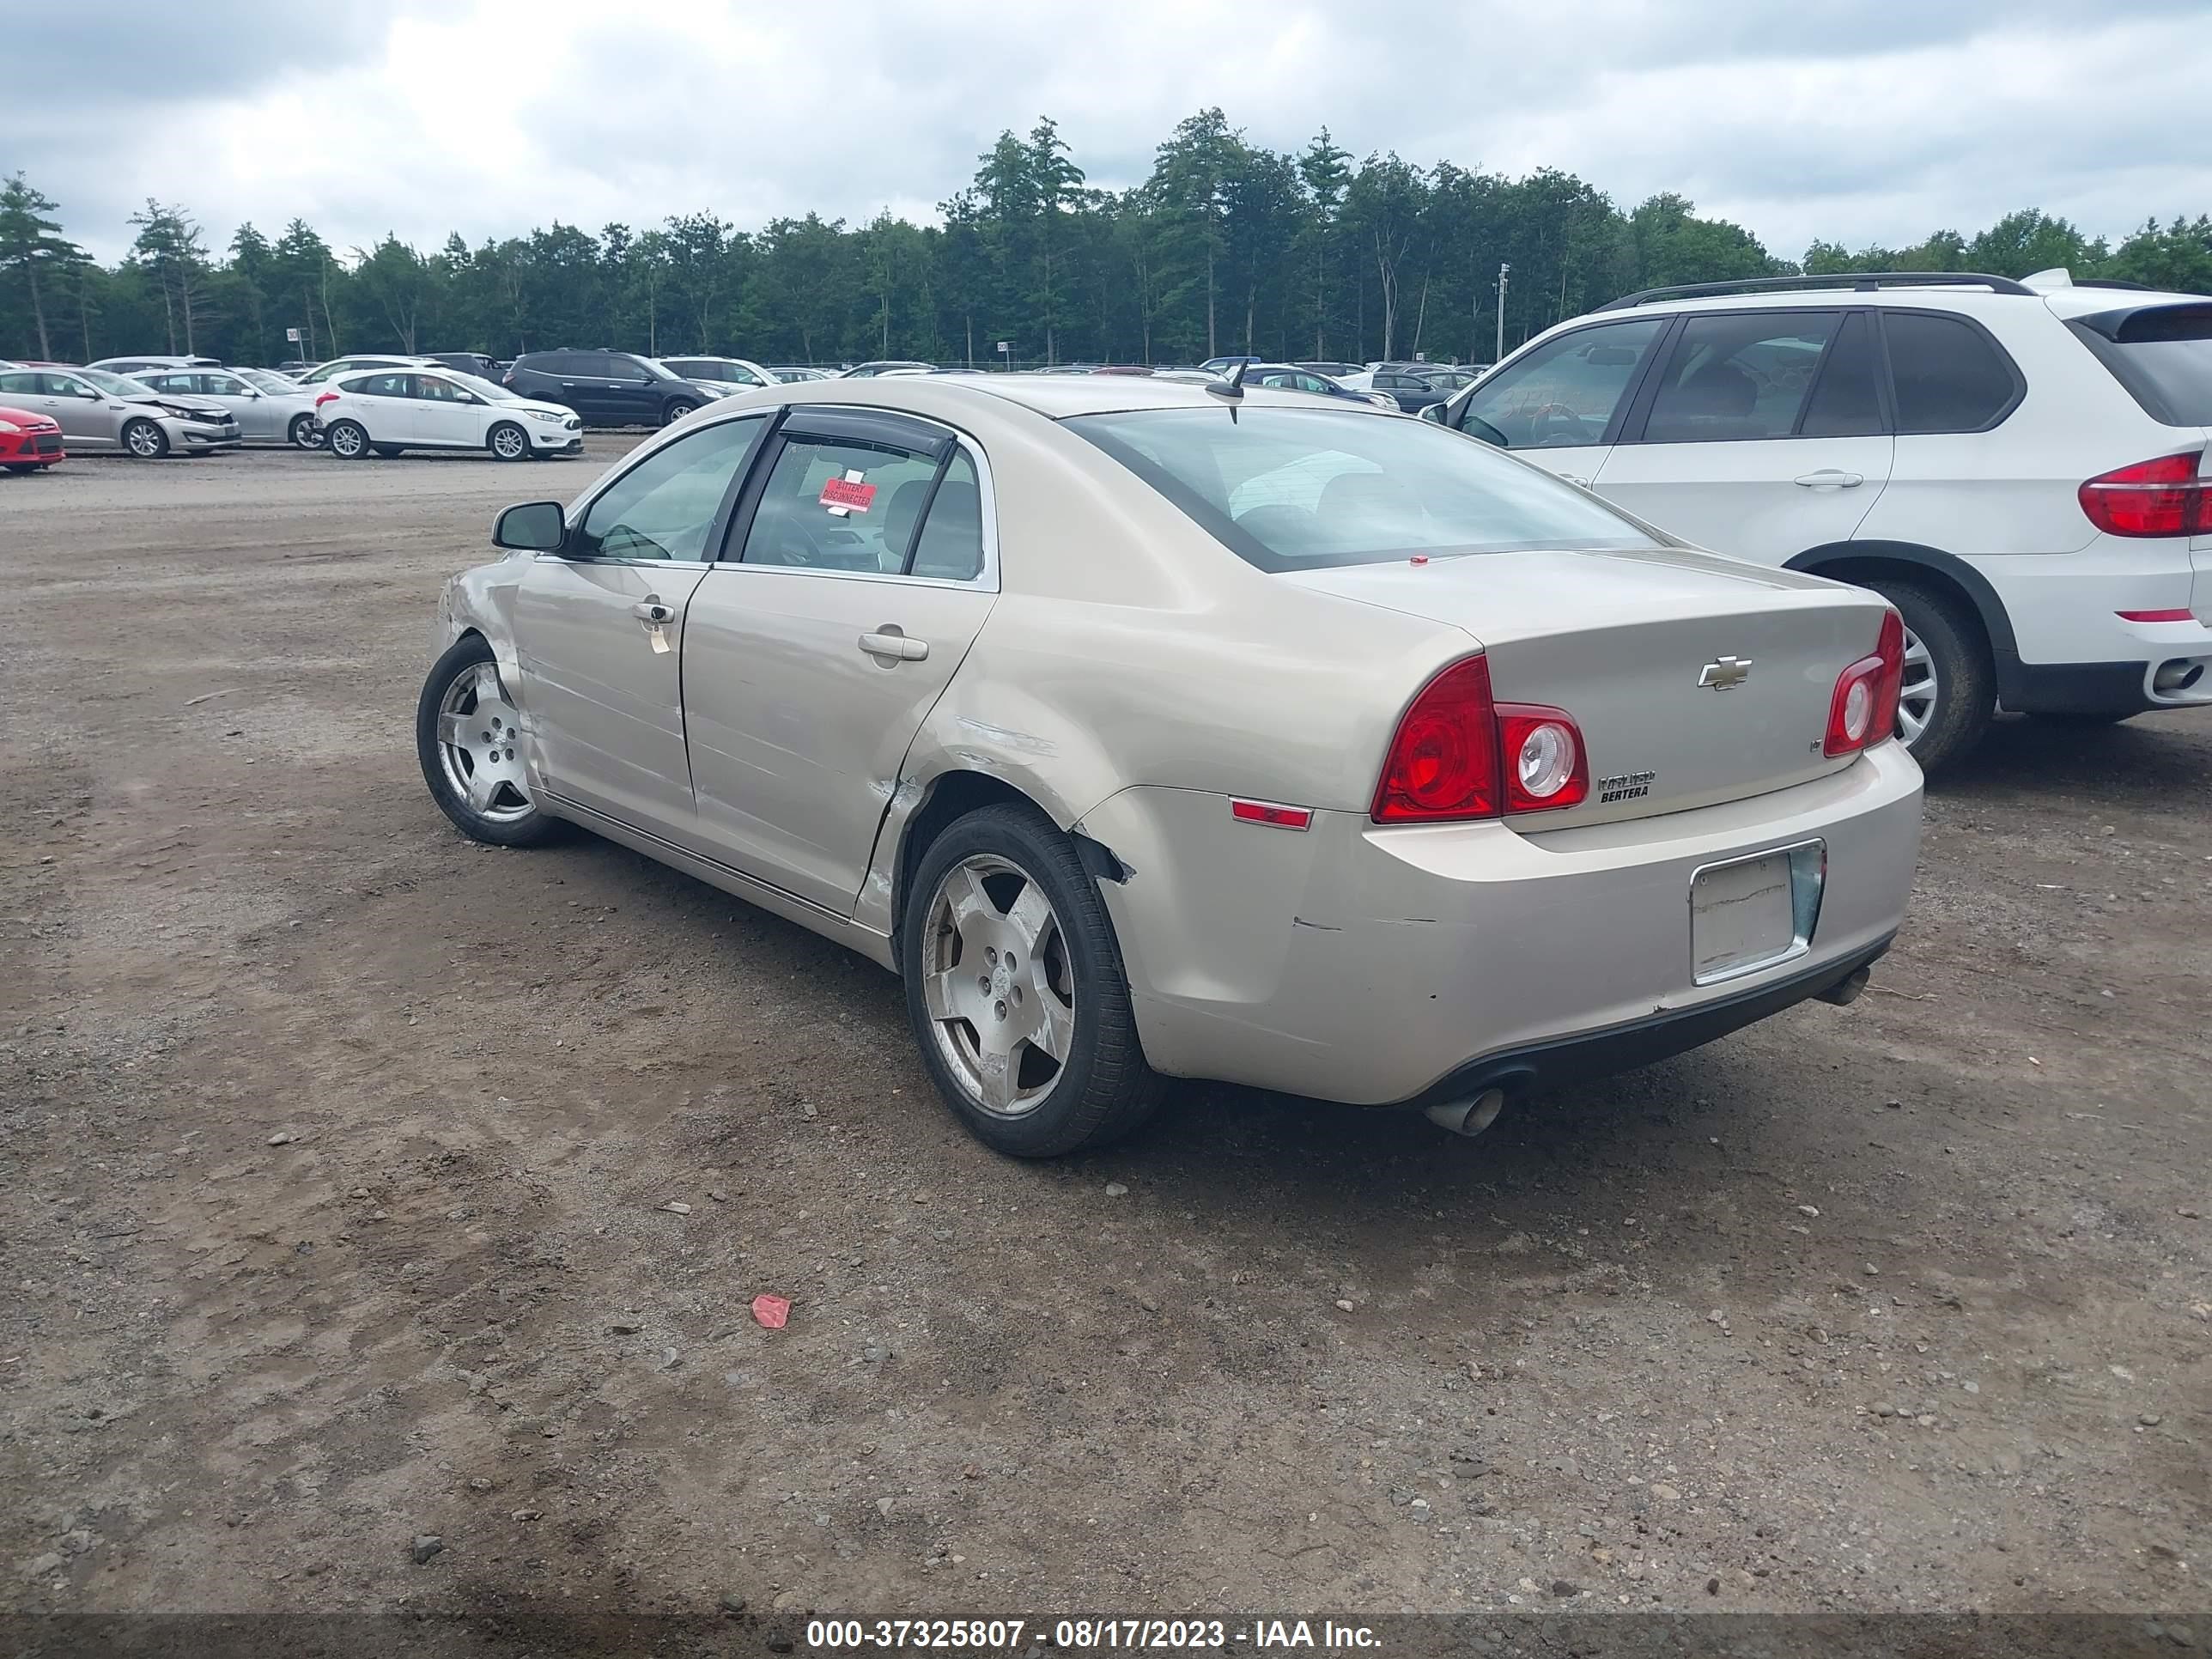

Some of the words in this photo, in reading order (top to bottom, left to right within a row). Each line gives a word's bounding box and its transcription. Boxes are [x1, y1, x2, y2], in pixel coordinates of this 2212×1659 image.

[836, 481, 866, 494] BATTERY
[823, 489, 871, 506] DISCONNECTED
[1600, 786, 1649, 804] BERTERA
